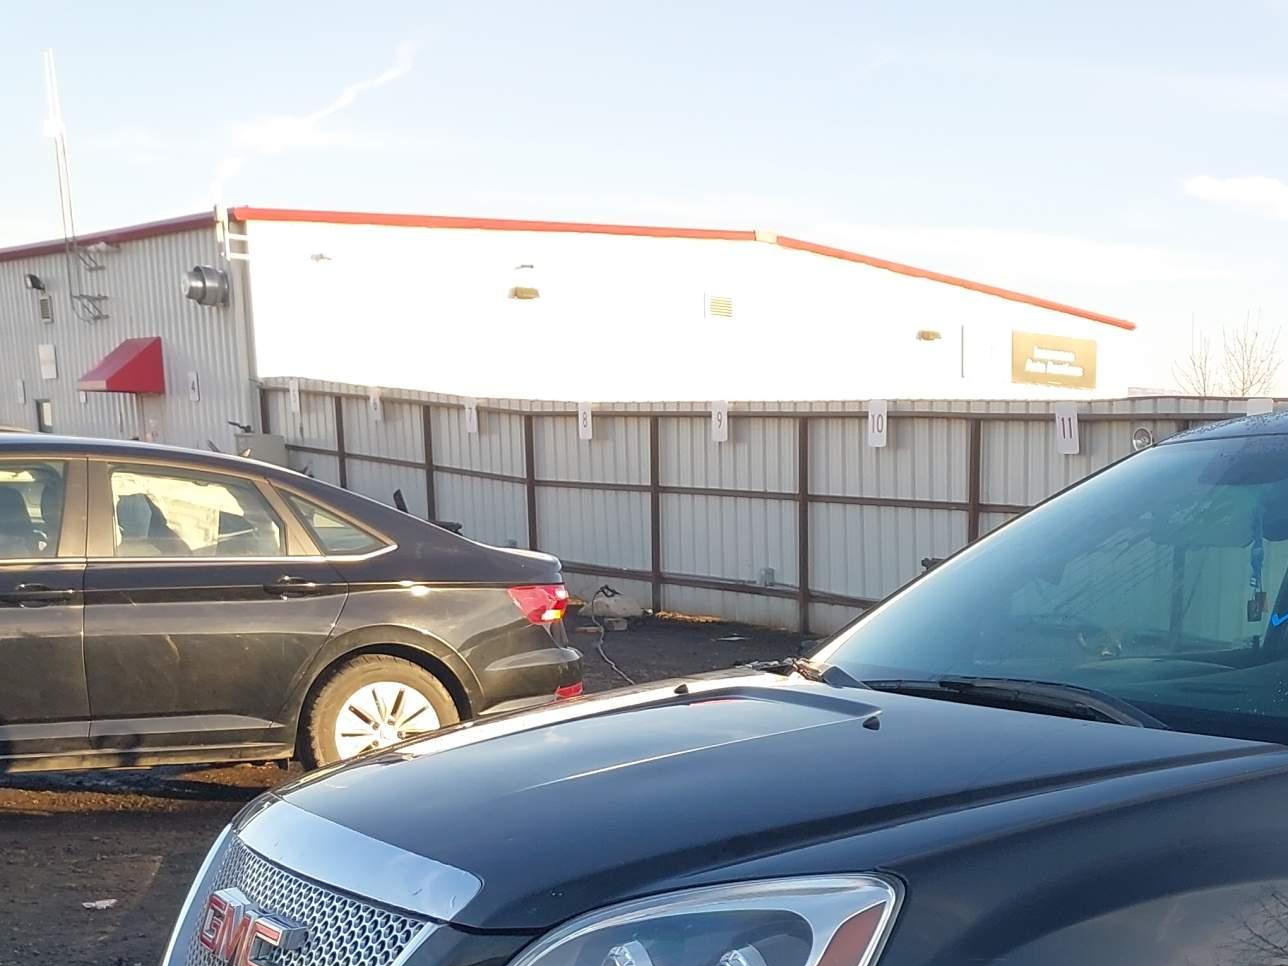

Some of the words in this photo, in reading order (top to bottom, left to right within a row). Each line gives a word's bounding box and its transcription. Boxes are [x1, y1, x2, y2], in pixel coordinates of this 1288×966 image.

[582, 411, 588, 428] 8
[716, 411, 723, 428] 9
[871, 414, 884, 433] 10
[1059, 416, 1074, 440] 11
